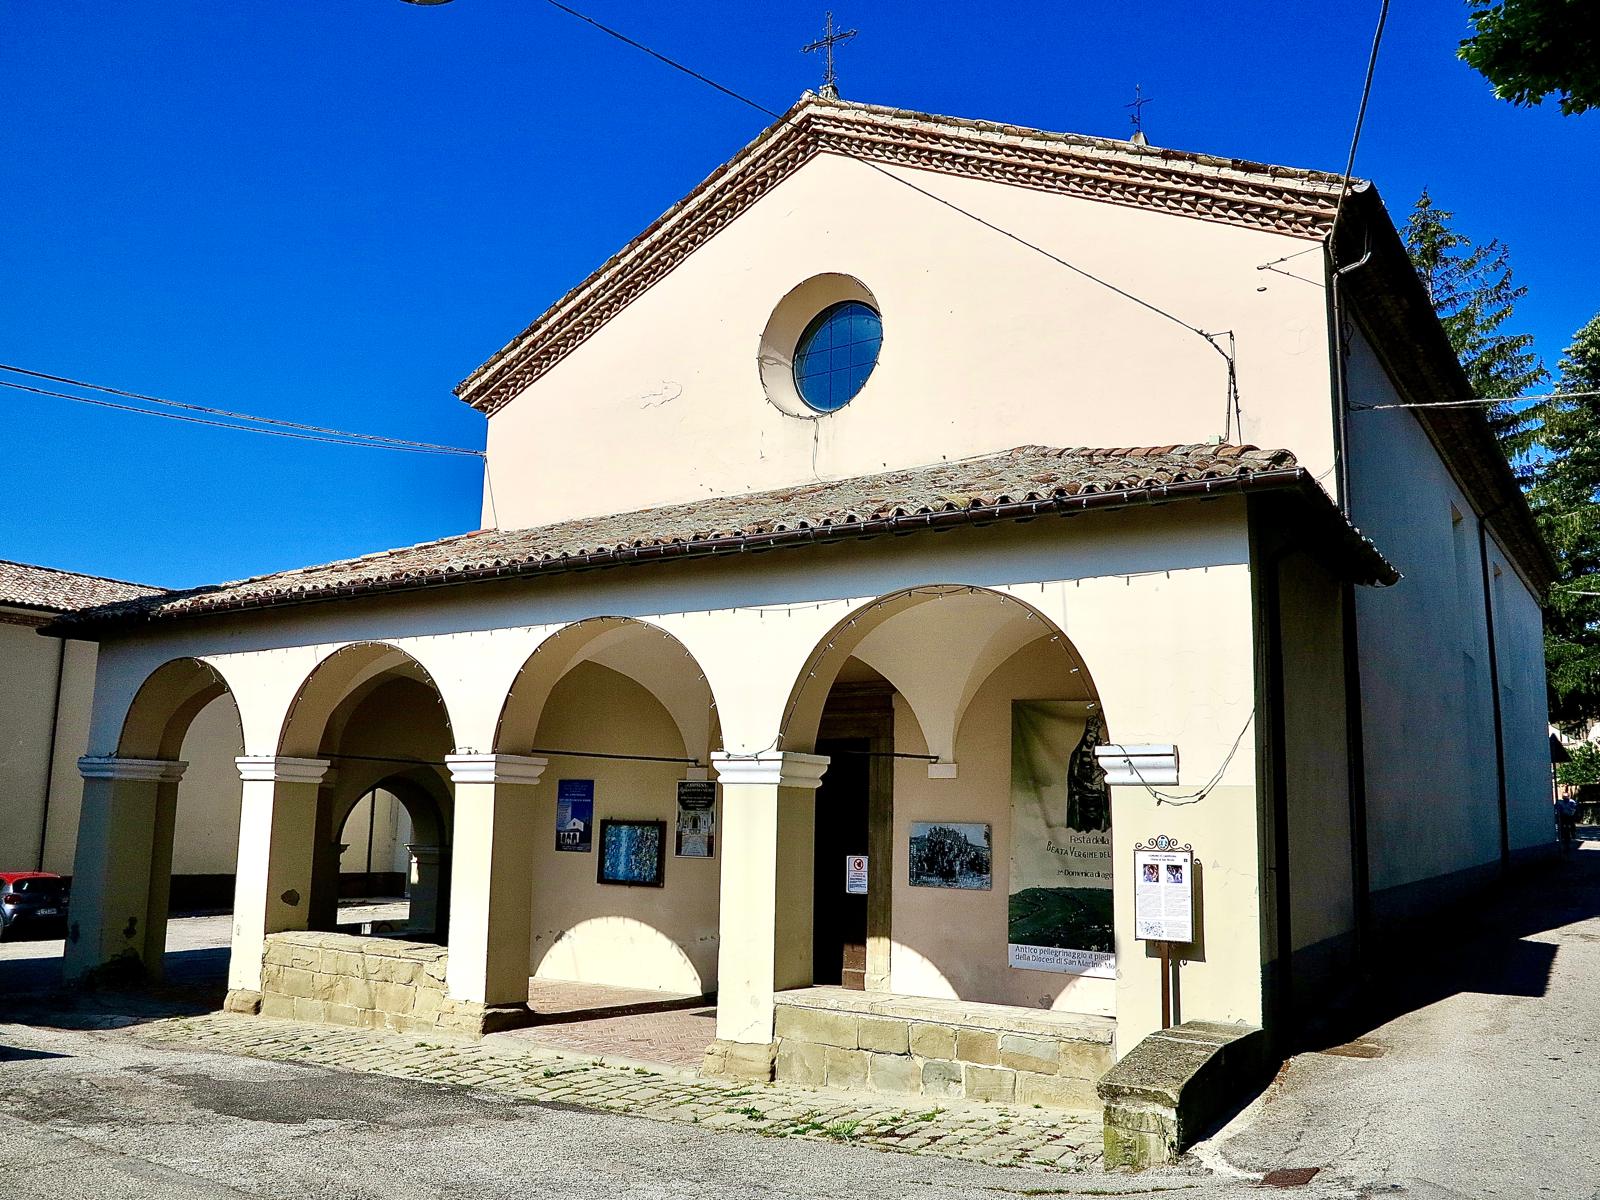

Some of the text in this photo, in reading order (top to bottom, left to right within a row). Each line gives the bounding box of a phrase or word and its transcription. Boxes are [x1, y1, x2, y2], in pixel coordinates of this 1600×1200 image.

[1070, 836, 1109, 844] Festa della
[1046, 840, 1068, 856] BEATA
[1070, 846, 1098, 858] VERGINE
[1015, 946, 1038, 954] Antico
[1040, 948, 1086, 959] pellegrinaggio
[1094, 952, 1110, 960] piedi
[1032, 955, 1054, 964] Diocesi
[1064, 958, 1076, 966] San
